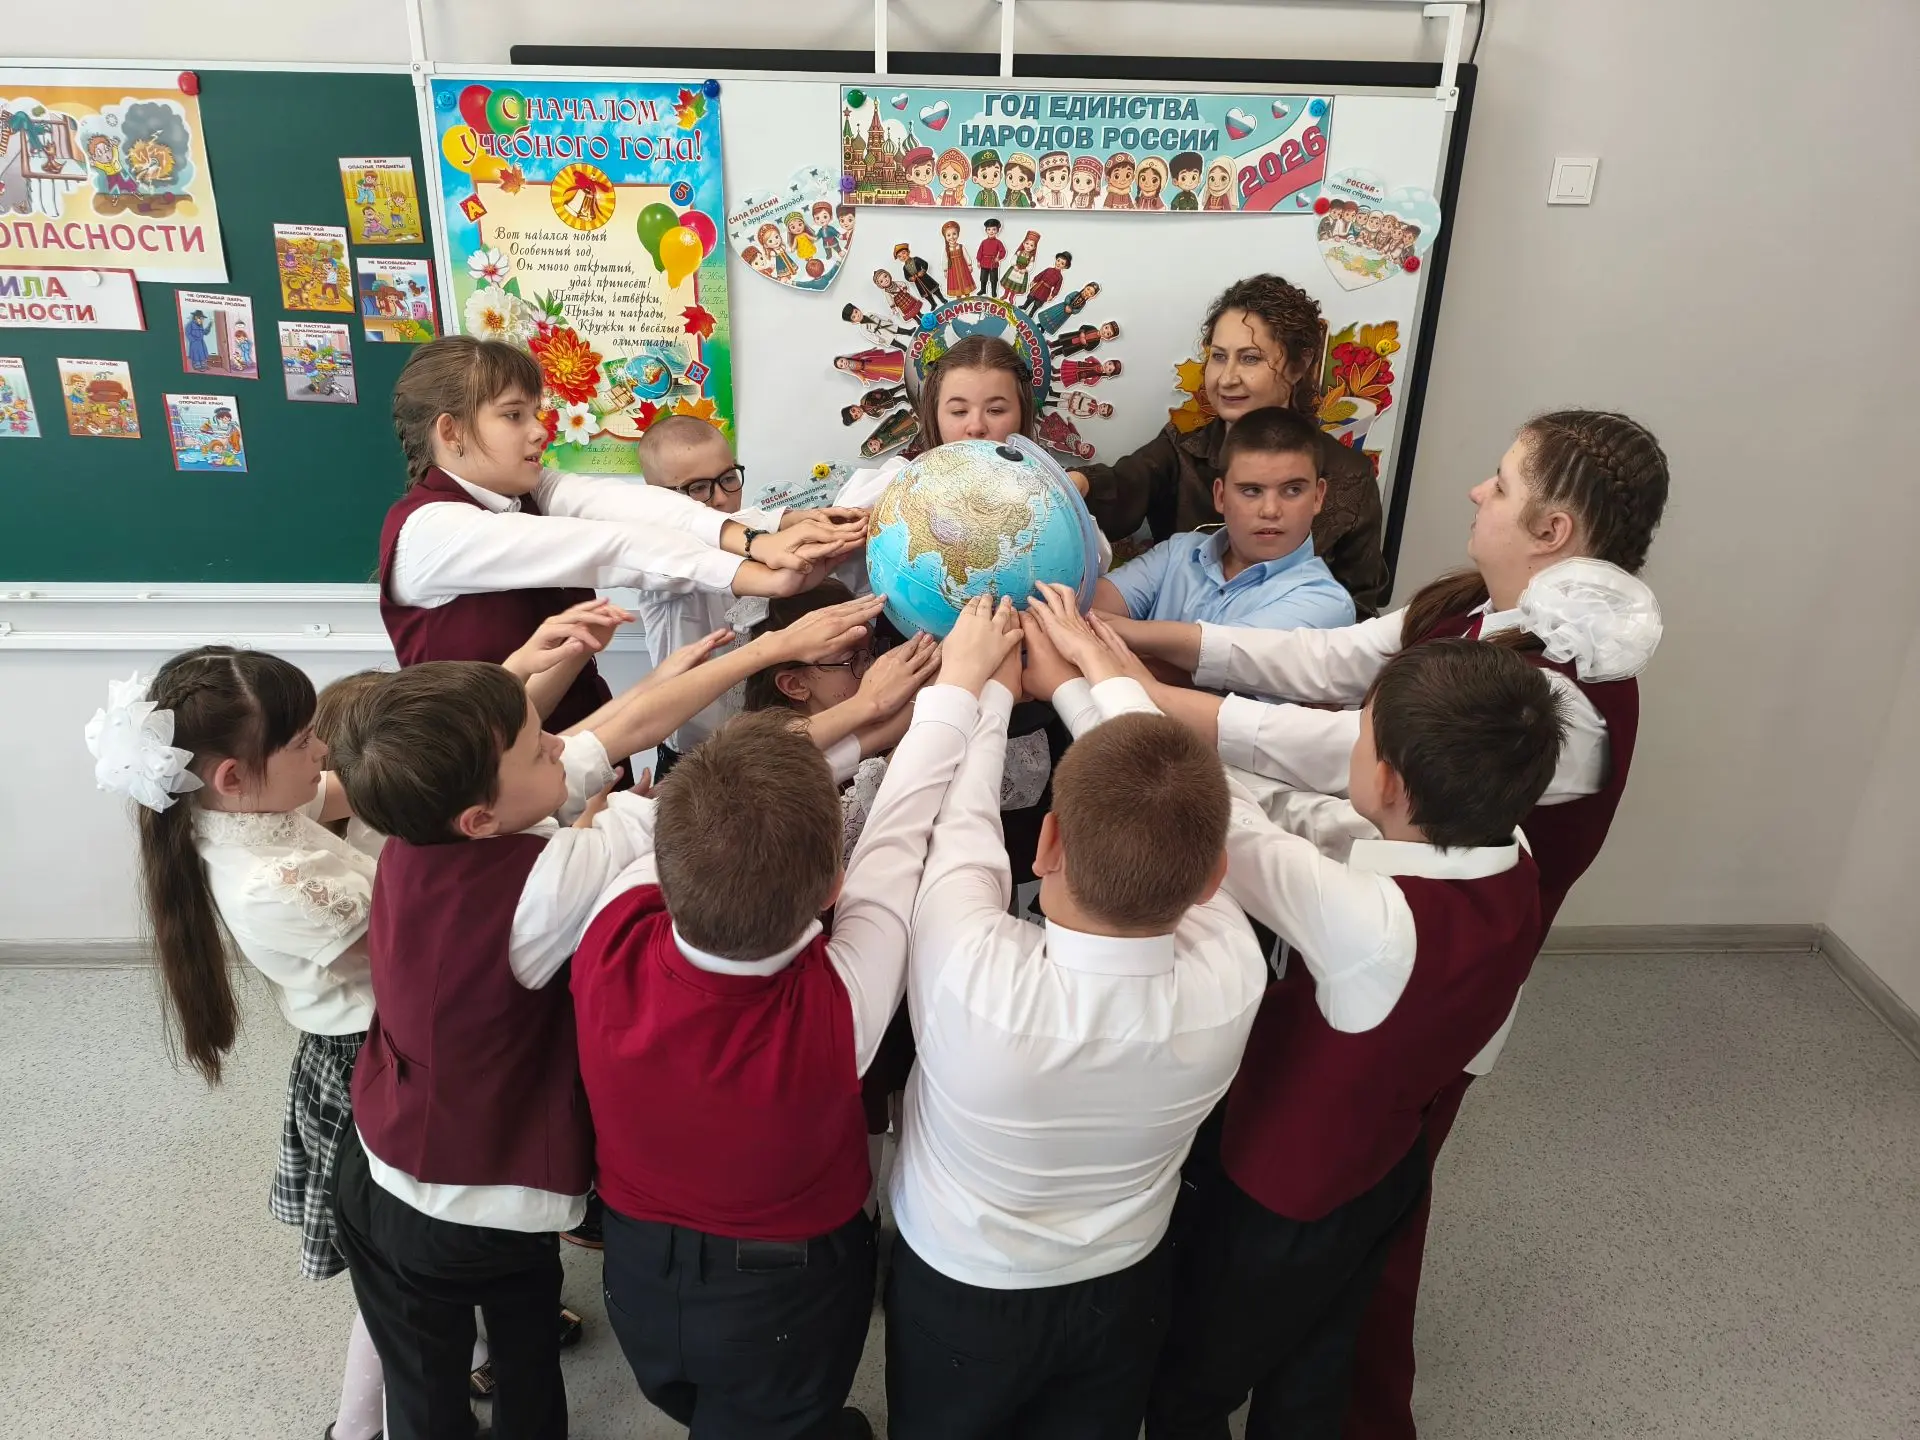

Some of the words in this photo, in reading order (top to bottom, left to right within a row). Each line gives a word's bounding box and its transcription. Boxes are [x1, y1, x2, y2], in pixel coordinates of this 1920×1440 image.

[502, 97, 519, 120] С
[526, 97, 658, 125] НАЧАЛОМ
[985, 94, 1041, 120] ГОД
[1049, 95, 1200, 121] ЕДИНСТВА
[619, 130, 702, 163] года!
[960, 124, 1094, 151] НАРОДОВ
[1102, 127, 1220, 151] РОССИИ
[1237, 125, 1327, 198] 2026
[673, 183, 691, 200] 5
[1331, 183, 1351, 195] наша
[1351, 188, 1383, 204] страна!
[1345, 178, 1376, 194] РОССИЯ
[468, 200, 483, 221] А
[728, 211, 750, 225] СИЛА
[749, 196, 780, 217] РОССИИ
[747, 208, 774, 228] дружбе
[774, 194, 805, 214] народов
[494, 226, 520, 240] Вот
[572, 230, 608, 242] новый
[509, 242, 571, 257] Особенный
[516, 257, 534, 271] Он
[537, 262, 569, 272] много
[573, 260, 635, 276] открытий,
[596, 276, 652, 292] принесёт!
[564, 304, 604, 320] Призы
[607, 309, 616, 317] и
[577, 318, 624, 336] Кружки
[628, 324, 636, 333] и
[640, 323, 680, 333] весёлые
[910, 331, 931, 359] ГОД
[936, 301, 1008, 324] ЕДИНСТВА
[1015, 320, 1045, 387] НАРОДОВ
[760, 490, 788, 505] РОССИЯ
